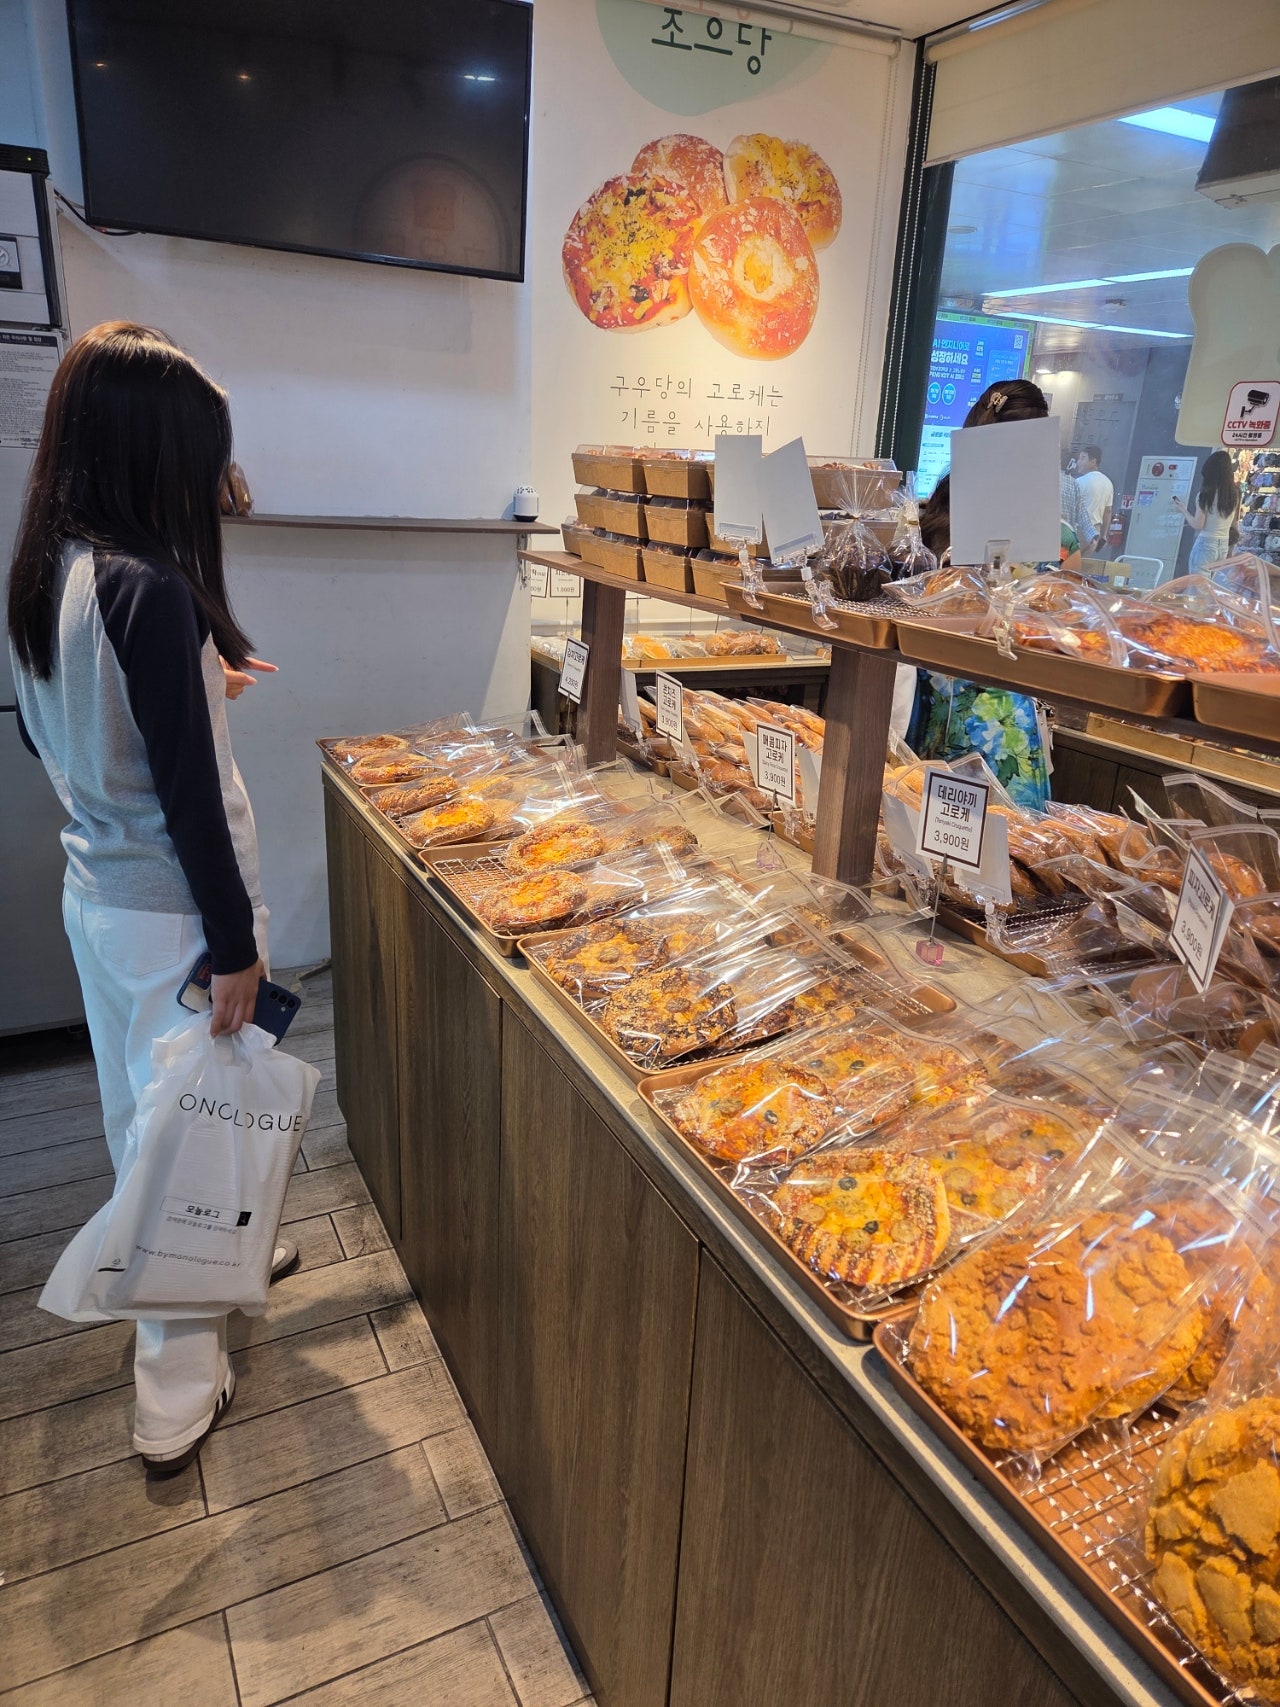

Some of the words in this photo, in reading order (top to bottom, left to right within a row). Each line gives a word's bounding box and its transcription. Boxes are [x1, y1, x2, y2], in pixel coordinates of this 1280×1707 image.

[651, 7, 772, 75] 조으당
[930, 349, 969, 366] 성장하세요
[610, 374, 692, 399] 구우당의
[706, 383, 783, 407] 고로케는
[621, 407, 681, 435] 기름을
[694, 414, 770, 437] 사용하지
[1227, 420, 1248, 429] CCTV
[1248, 420, 1271, 429] 녹화중
[763, 734, 787, 752] 매콤피자
[766, 747, 785, 764] 고로케
[764, 770, 786, 788] 3,900원
[938, 785, 978, 808] 데리야끼
[940, 801, 971, 823] 고로케
[934, 830, 970, 851] 3,900원
[1181, 920, 1204, 962] 3,900원
[135, 1244, 241, 1268] www.bymonologue.co.kr
